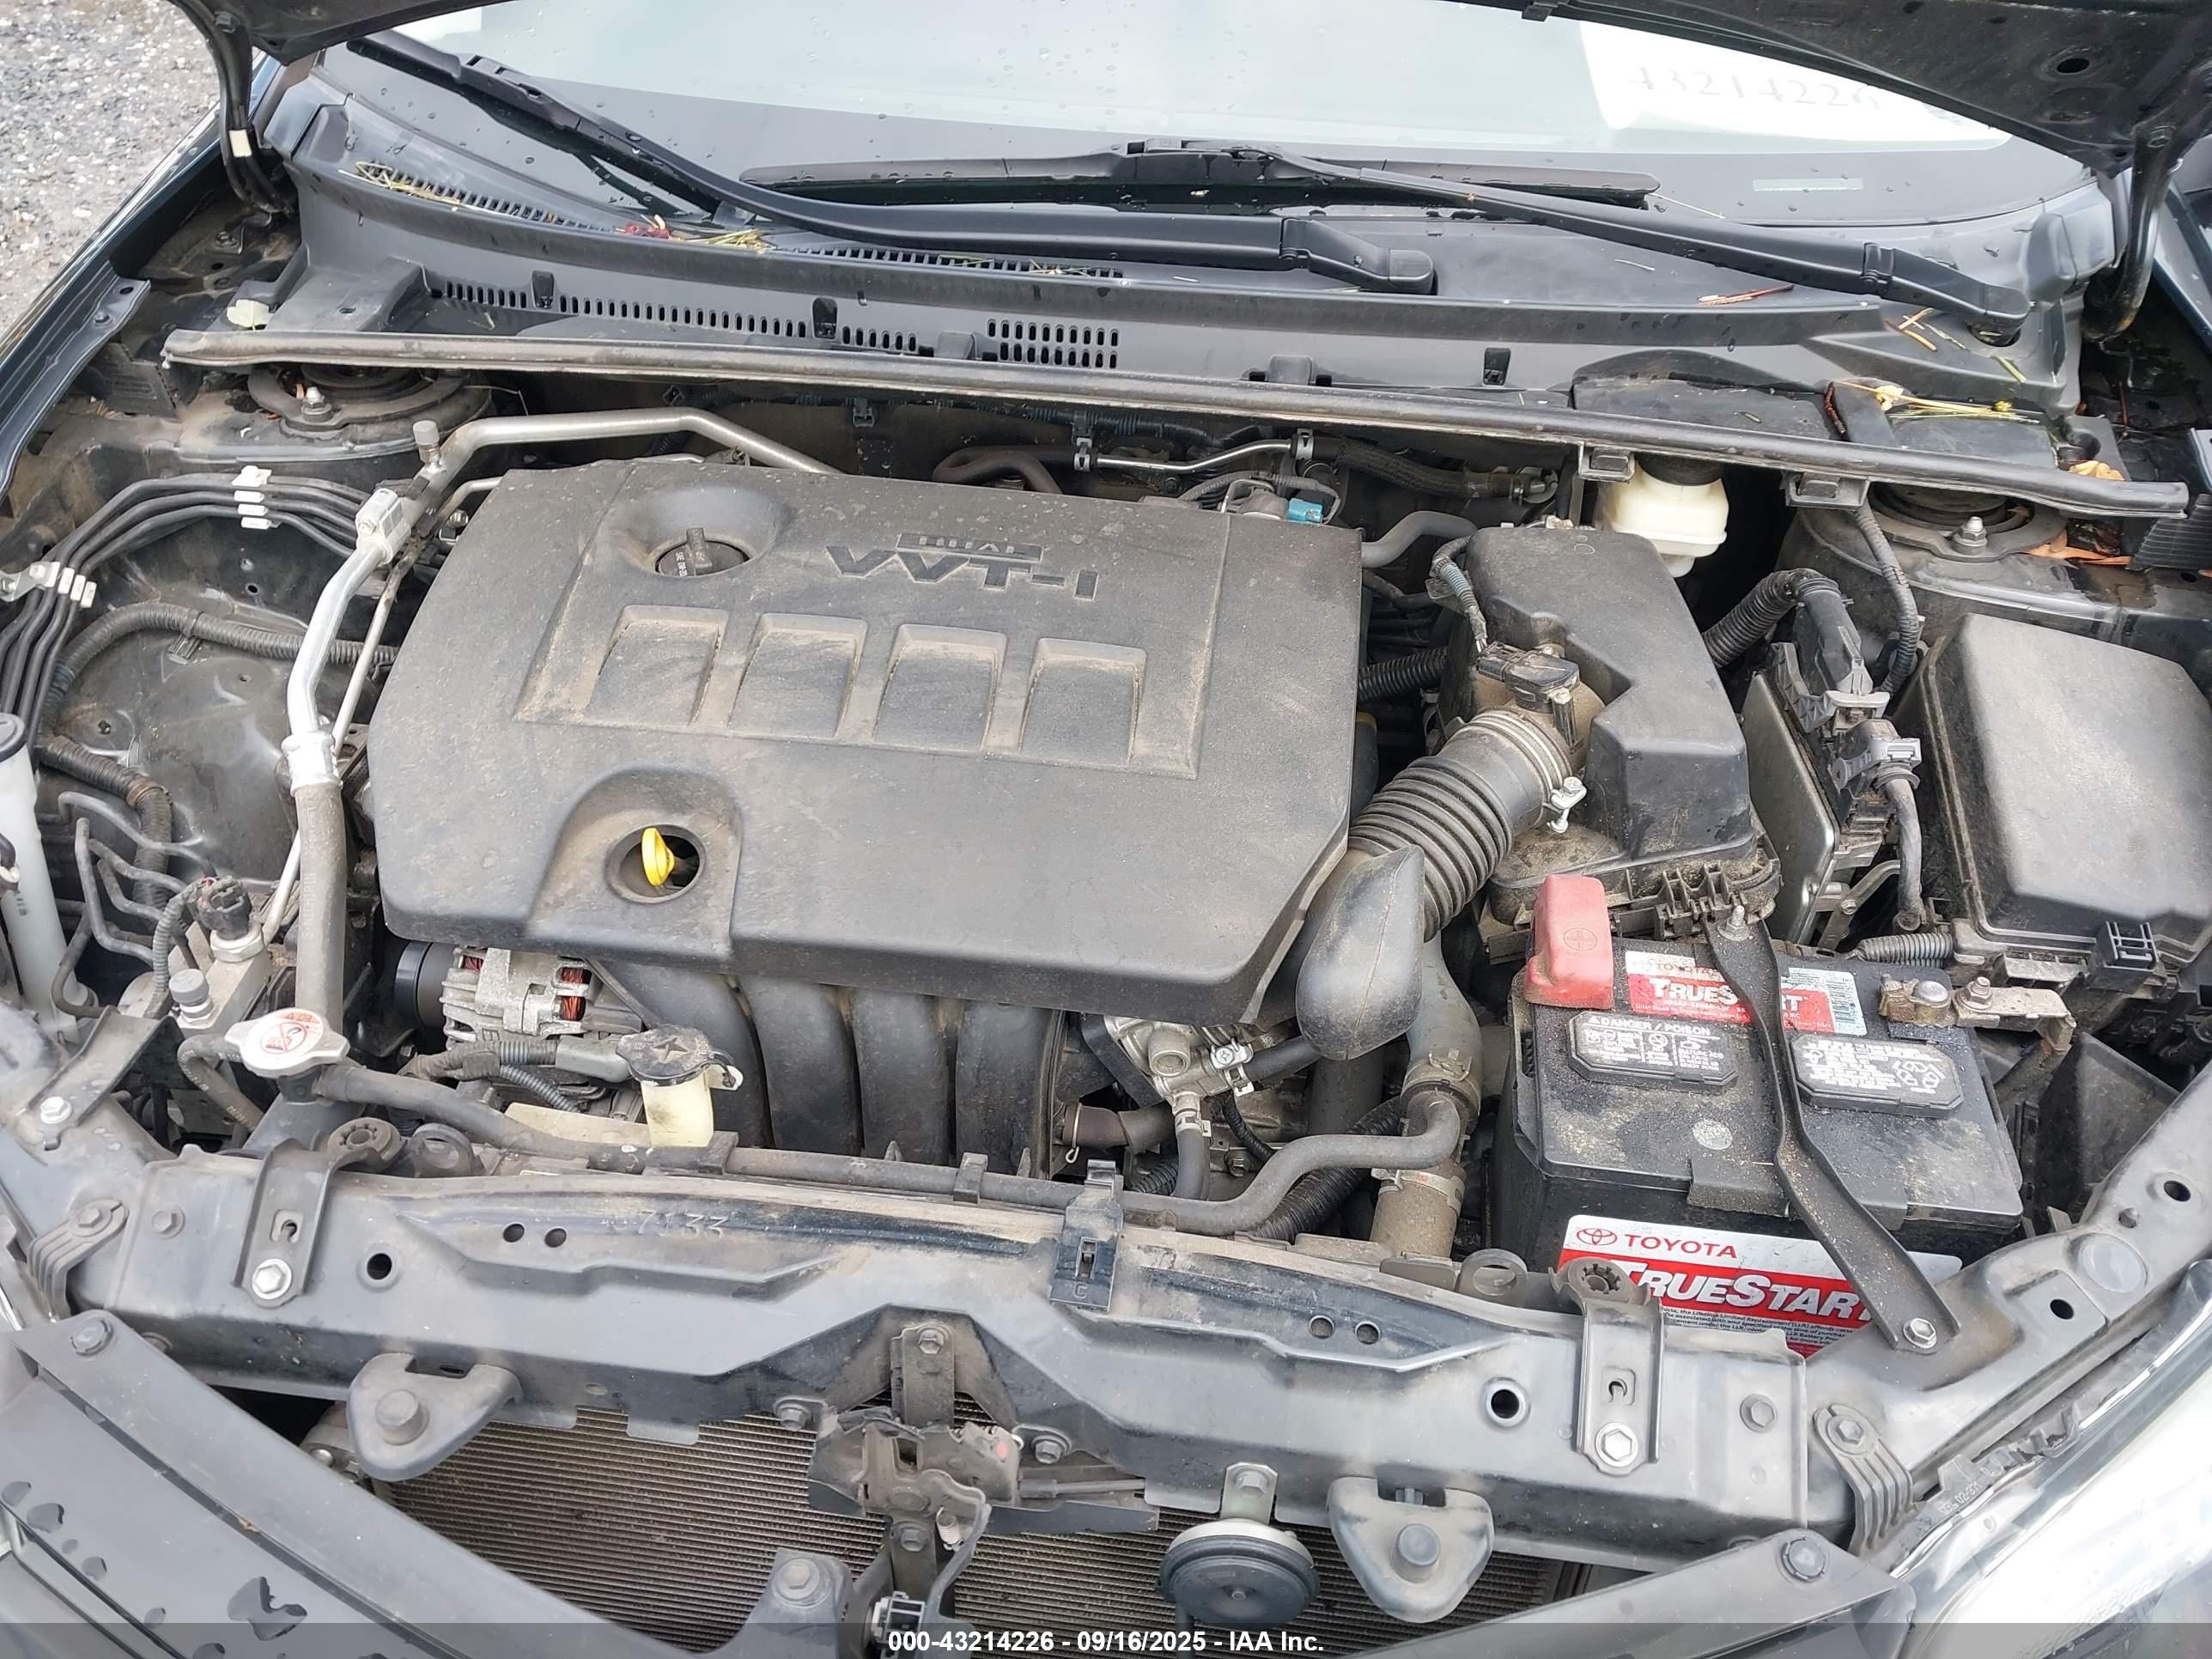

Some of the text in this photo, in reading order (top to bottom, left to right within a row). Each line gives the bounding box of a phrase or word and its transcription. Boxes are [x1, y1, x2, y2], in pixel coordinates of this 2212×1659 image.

[1601, 1016, 1652, 1030] DANGER
[1664, 1022, 1711, 1036] POISON
[1625, 1233, 1738, 1259] TOYOTA
